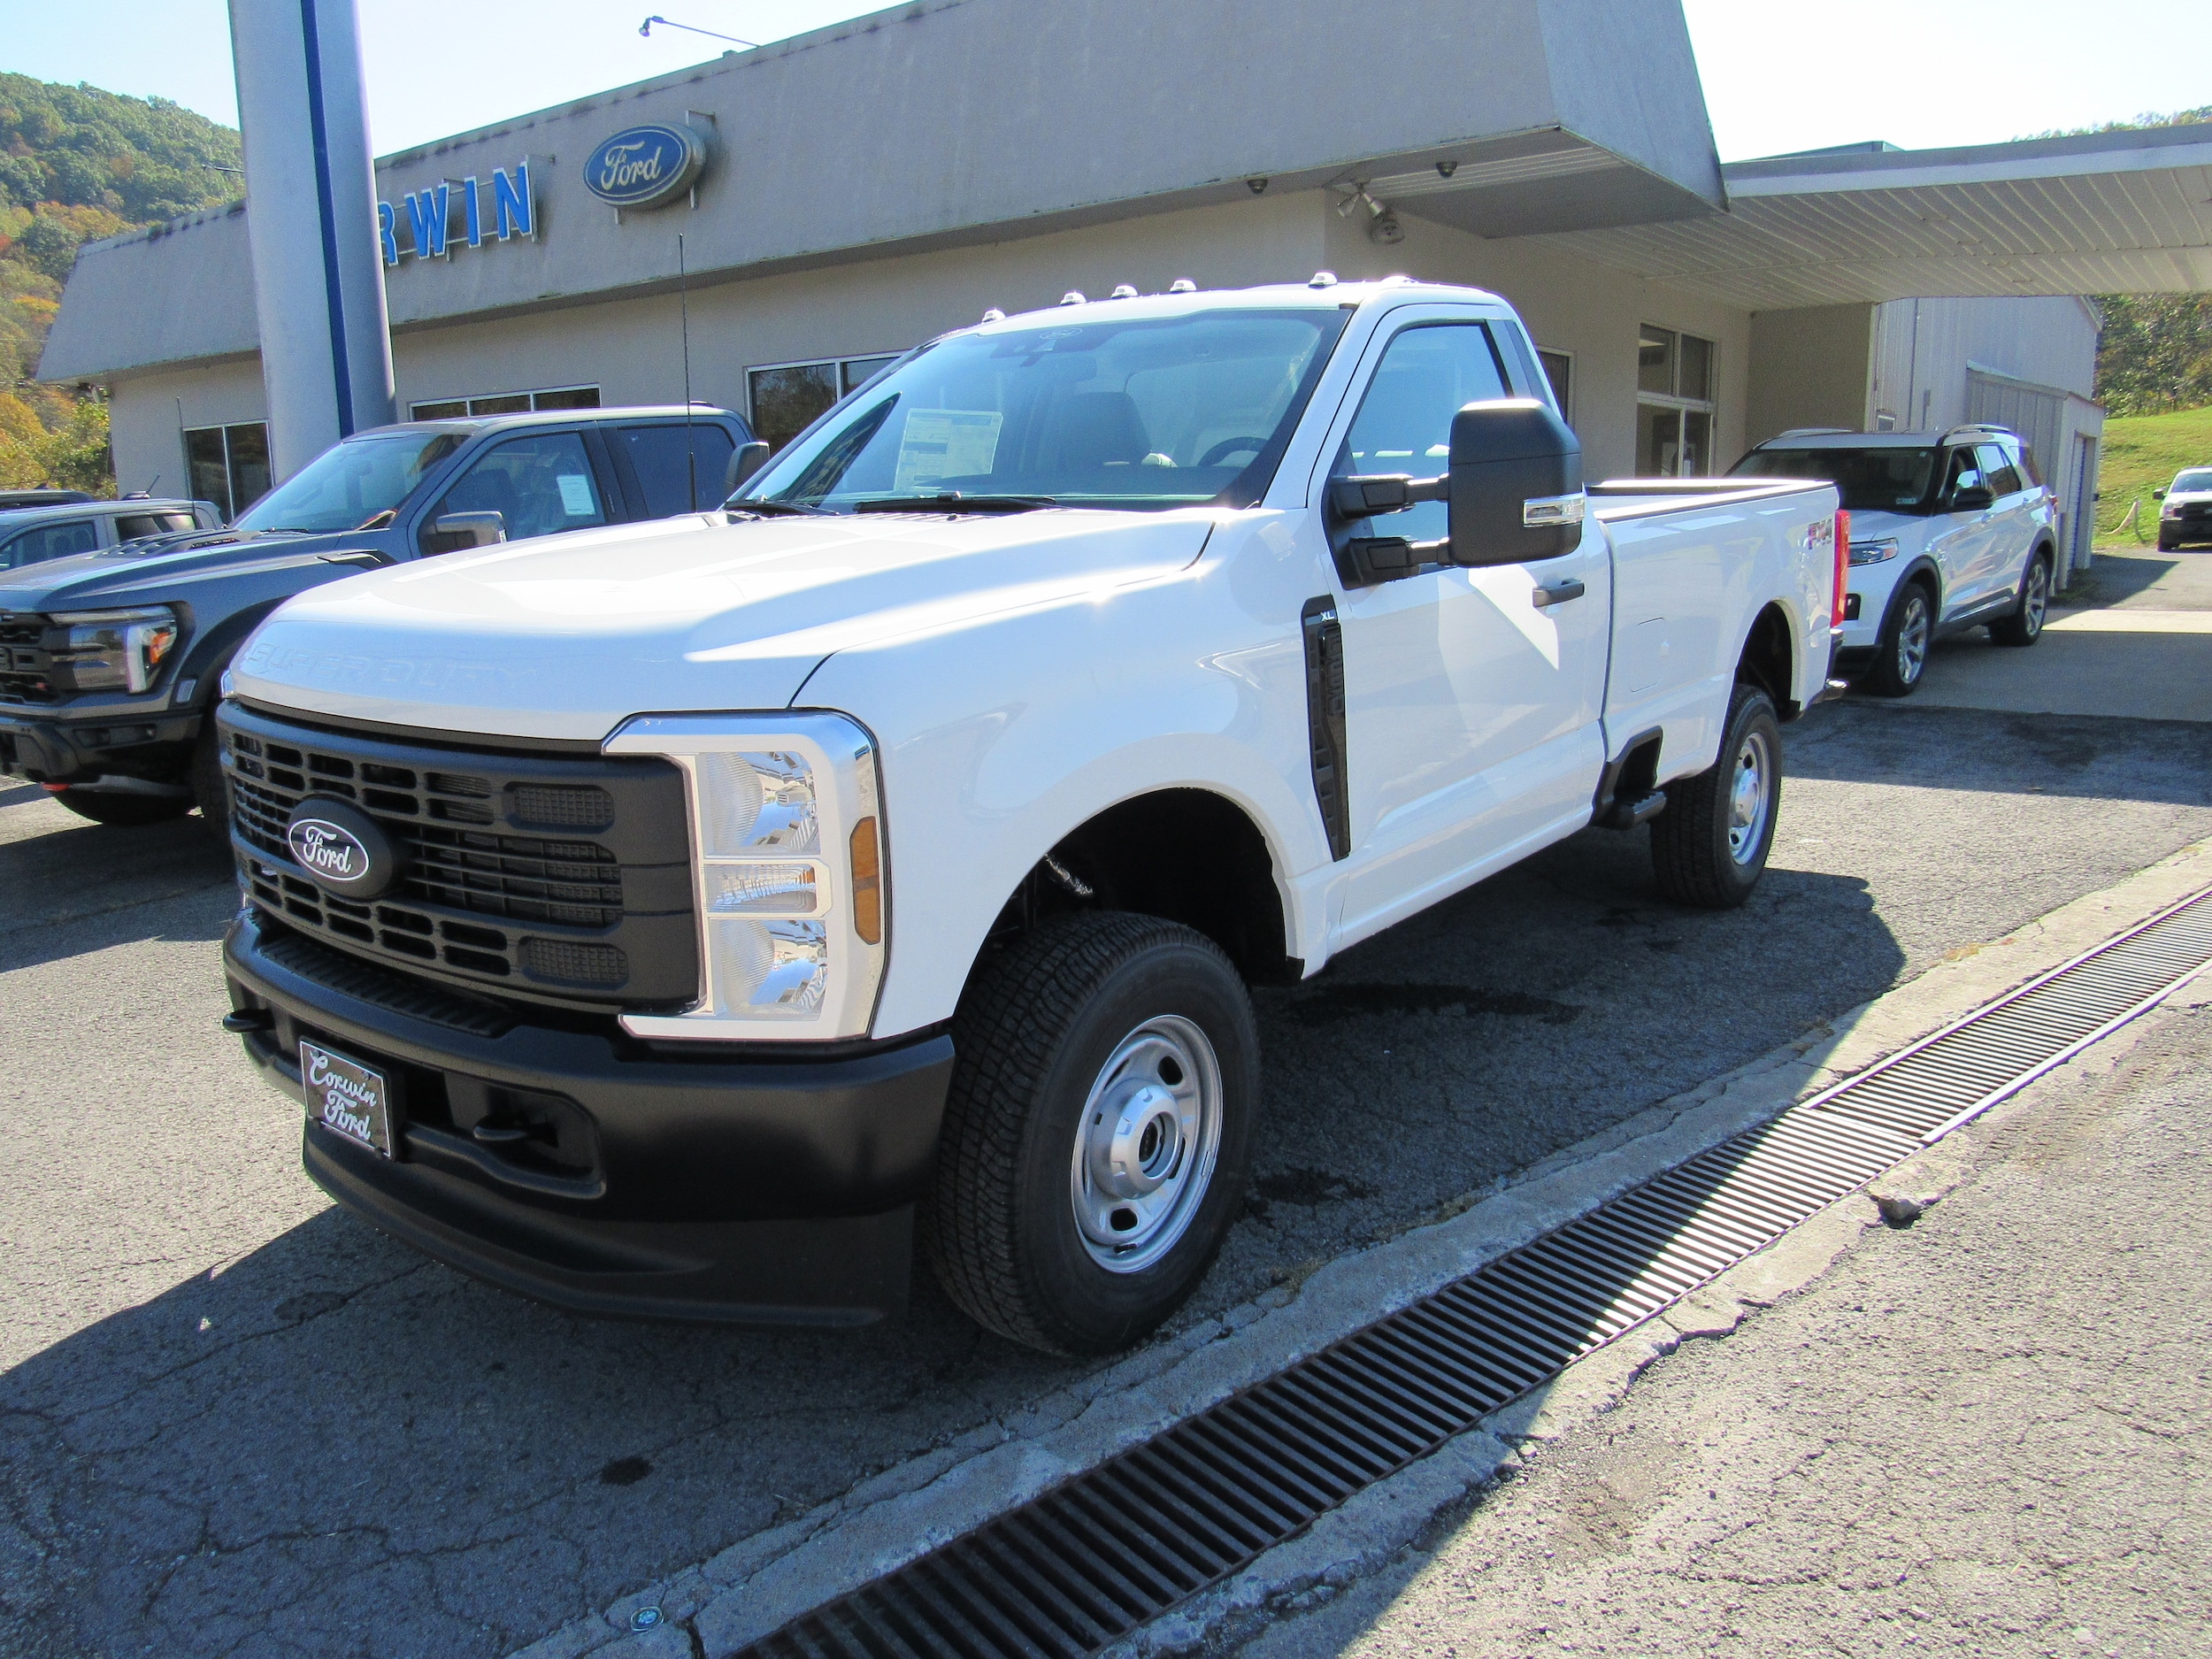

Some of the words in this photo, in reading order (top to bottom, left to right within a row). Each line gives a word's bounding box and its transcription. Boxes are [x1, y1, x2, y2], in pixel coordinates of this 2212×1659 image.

[600, 140, 663, 192] Ford
[378, 160, 533, 267] RWIN
[1319, 611, 1335, 622] XL
[247, 641, 372, 683] SUPER
[303, 825, 352, 873] Ford
[309, 1049, 379, 1107] Corwin
[324, 1088, 373, 1141] Ford
